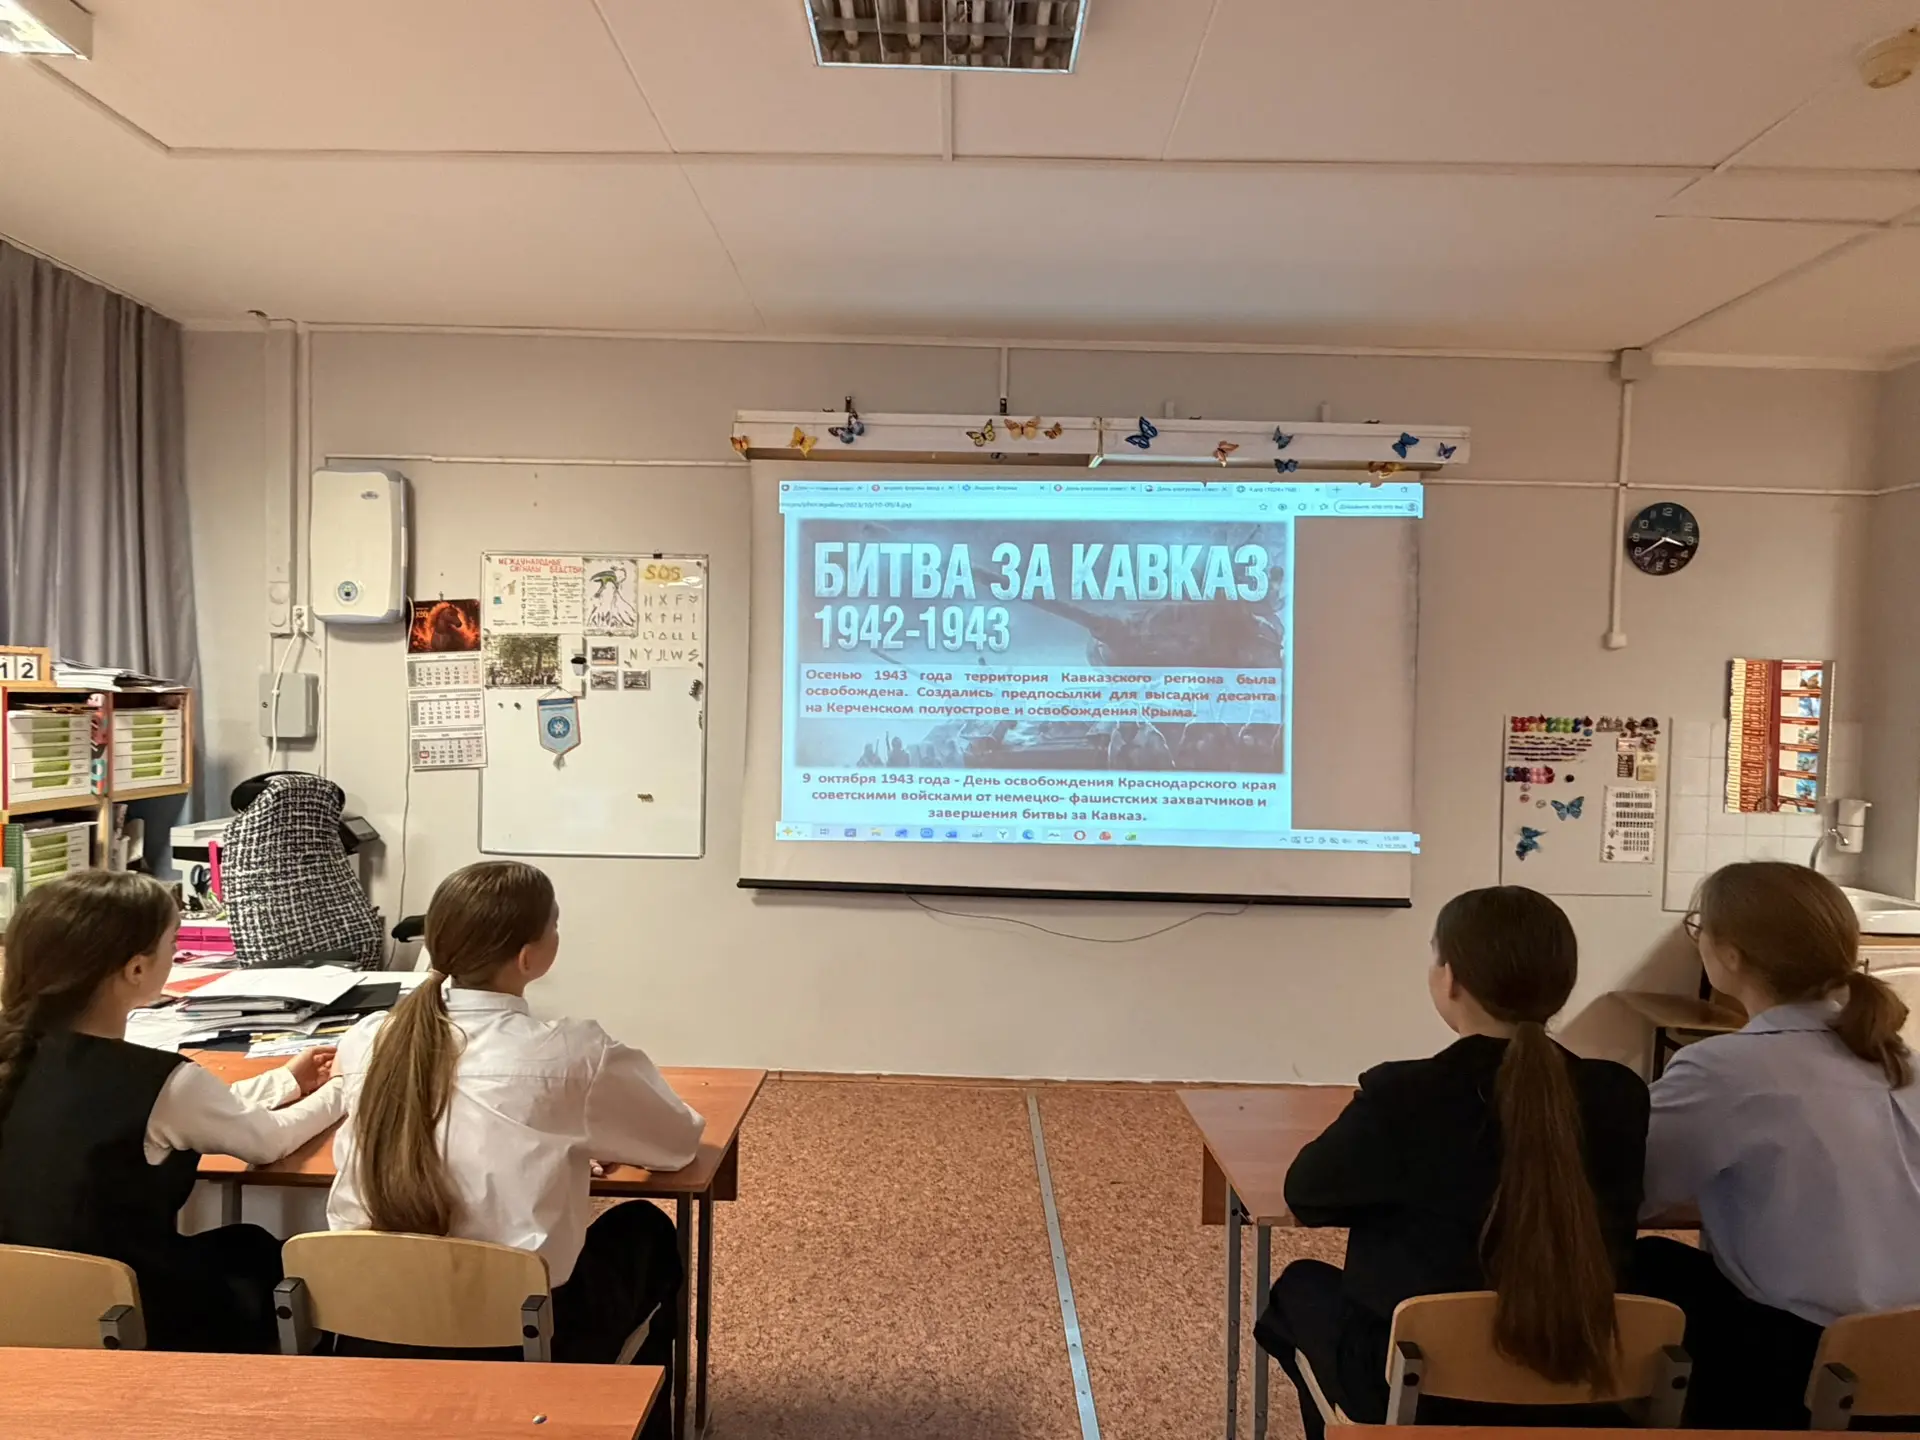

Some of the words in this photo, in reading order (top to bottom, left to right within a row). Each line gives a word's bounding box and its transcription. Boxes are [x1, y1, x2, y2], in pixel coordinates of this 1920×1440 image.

[644, 564, 681, 580] SOS
[814, 542, 975, 600] БИТВА
[991, 543, 1055, 600] ЗА
[1072, 543, 1268, 601] КАВКАЗ
[814, 605, 1010, 650] 1942-1943
[806, 669, 862, 680] Осенью
[874, 670, 908, 681] 1943
[920, 672, 952, 682] года
[965, 672, 1048, 684] территория
[1062, 672, 1151, 684] Кавказского
[1164, 674, 1224, 686] региона
[1237, 673, 1276, 684] была
[806, 685, 908, 698] освобождена.
[917, 687, 993, 699] Создались
[1001, 688, 1101, 700] предпосылки
[1109, 691, 1137, 701] для
[1146, 690, 1209, 702] высадки
[1217, 692, 1276, 703] десанта
[806, 704, 822, 713] на
[827, 702, 913, 715] Керченском
[919, 704, 1009, 717] полуострове
[1015, 706, 1024, 715] и
[1028, 704, 1137, 718] освобождения
[1142, 706, 1197, 719] Крыма.
[802, 773, 811, 783] 9
[818, 773, 877, 786] октября
[881, 774, 914, 784] 1943
[918, 776, 951, 786] года
[963, 775, 1000, 787] День
[1004, 776, 1114, 788] освобождения
[1118, 777, 1237, 791] Краснодарского
[1242, 781, 1276, 792] края
[811, 791, 896, 801] советскими
[901, 790, 972, 802] войсками
[976, 793, 992, 802] от
[995, 793, 1065, 805] немецко-
[1069, 793, 1158, 806] фашистских
[1162, 796, 1254, 807] захватчиков
[1258, 798, 1267, 807] и
[928, 808, 1017, 820] завершения
[1022, 809, 1067, 820] битвы
[1071, 811, 1087, 820] за
[1091, 810, 1147, 822] Кавказ.
